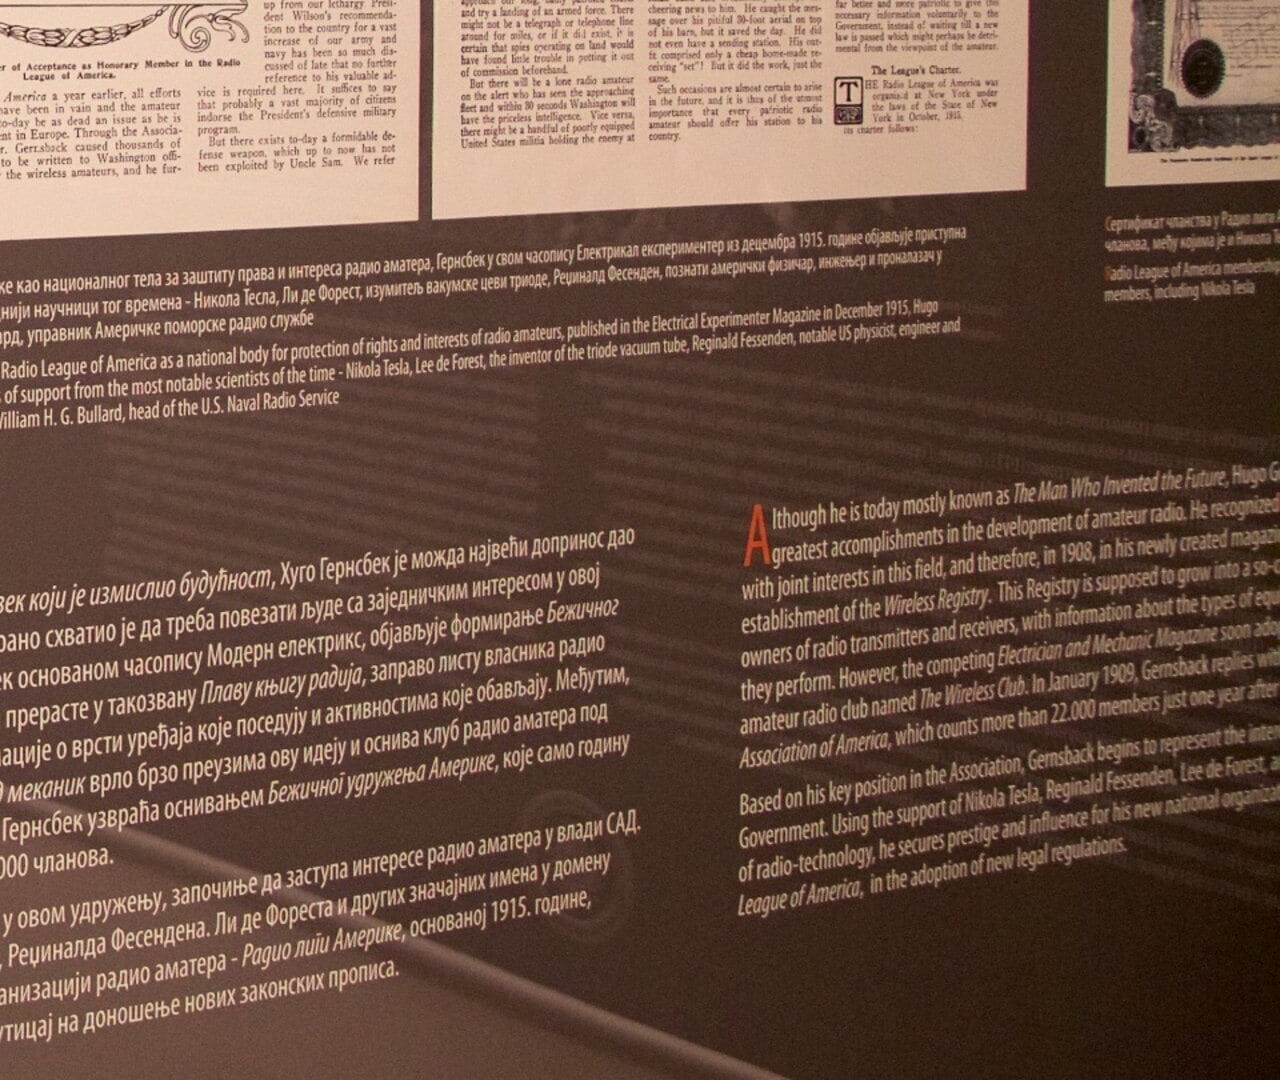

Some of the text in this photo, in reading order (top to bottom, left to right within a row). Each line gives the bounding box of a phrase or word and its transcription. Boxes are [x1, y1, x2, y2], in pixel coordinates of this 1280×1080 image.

[27, 326, 92, 348] управник
[95, 321, 161, 342] Америчке
[164, 317, 226, 337] поморске
[229, 315, 267, 335] радио
[270, 308, 314, 332] службе
[44, 408, 57, 426] H.
[60, 406, 73, 426] G.
[77, 403, 125, 425] Bullard,
[129, 400, 159, 421] head
[163, 398, 176, 418] of
[178, 398, 198, 417] the
[202, 395, 224, 415] U.S.
[227, 392, 260, 413] Naval
[263, 390, 296, 410] Radio
[299, 388, 339, 408] Service
[29, 589, 68, 617] који
[70, 588, 86, 614] је
[90, 579, 176, 606] измислио
[180, 567, 275, 602] будућност,
[281, 561, 315, 590] Хуго
[320, 551, 390, 585] Гернсбек
[393, 549, 407, 579] је
[412, 547, 464, 570] можда
[469, 535, 528, 567] највећи
[531, 530, 604, 560] допринос
[607, 527, 635, 551] дао
